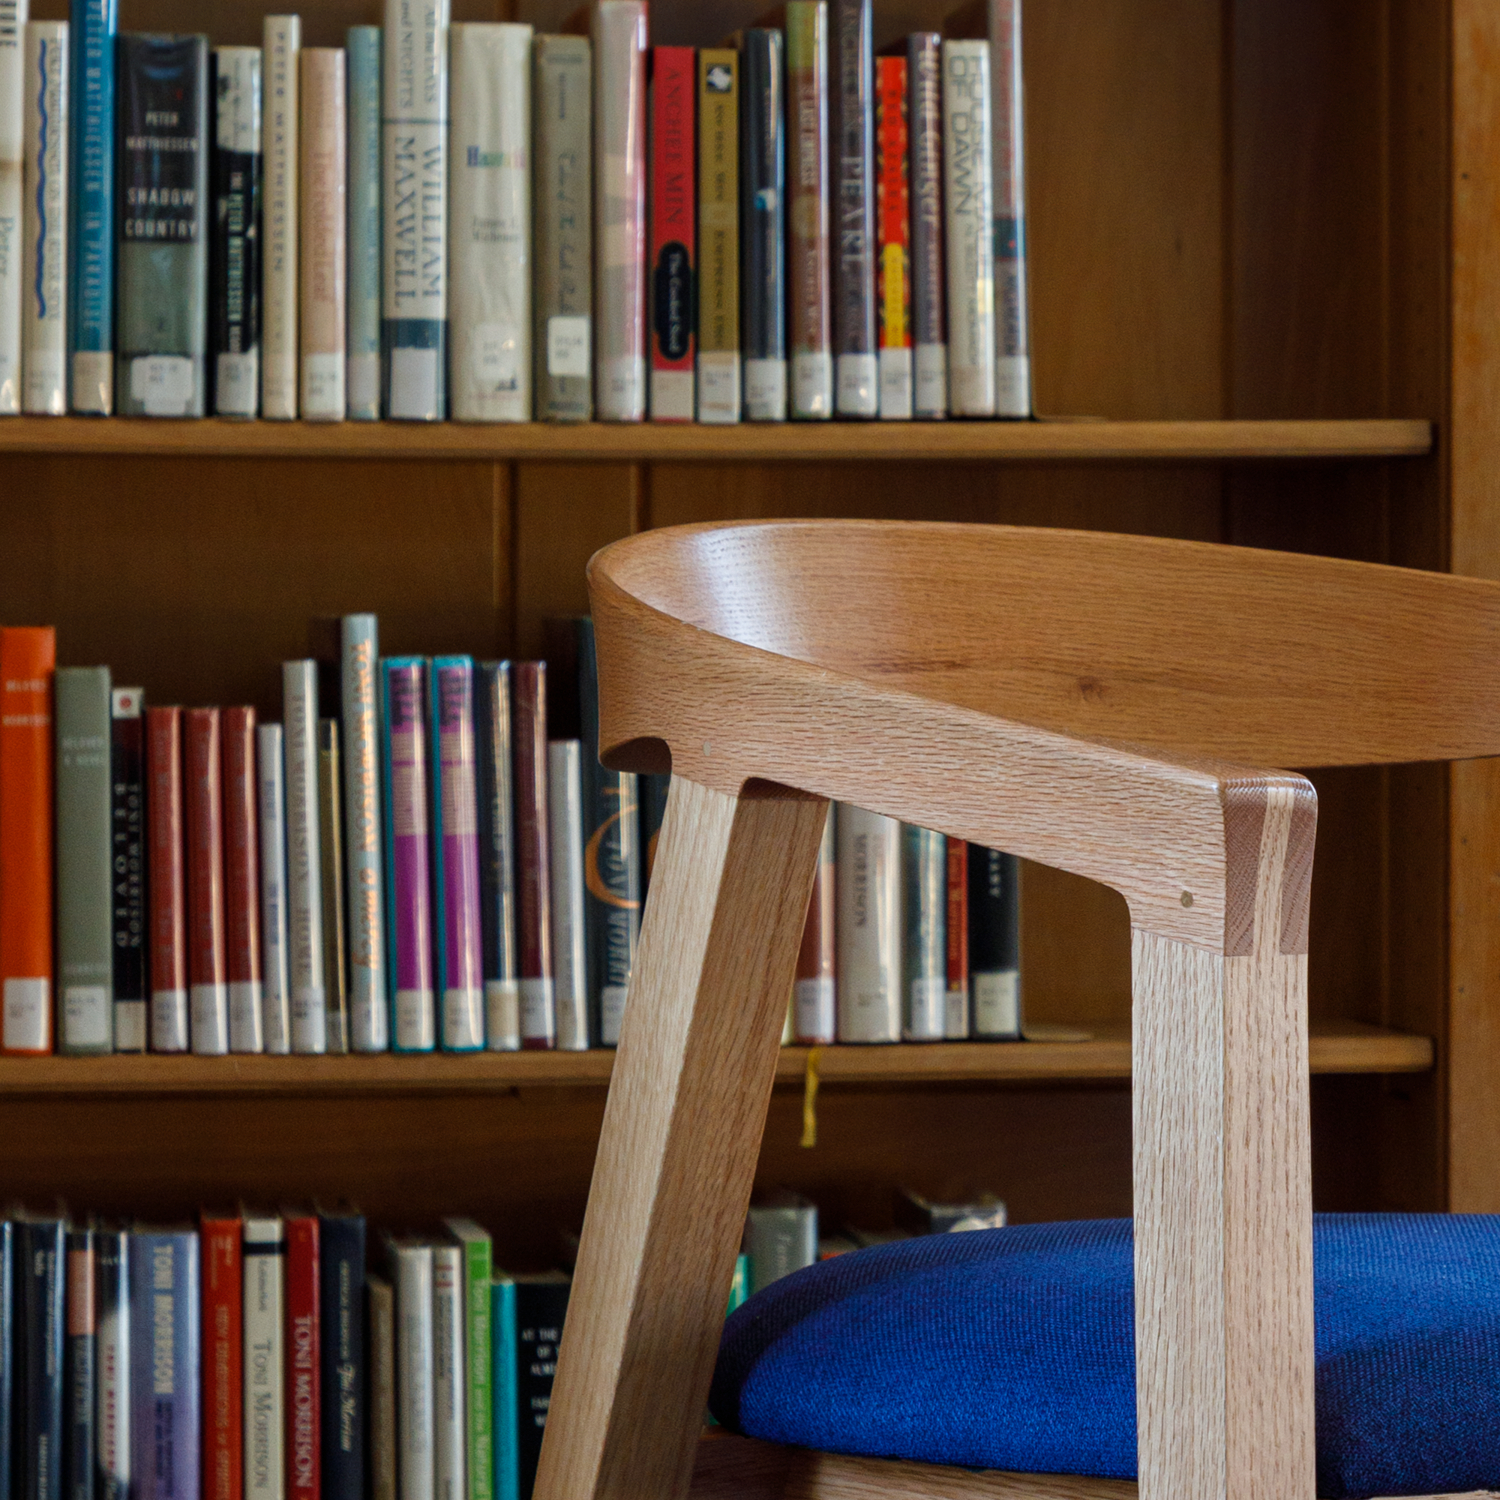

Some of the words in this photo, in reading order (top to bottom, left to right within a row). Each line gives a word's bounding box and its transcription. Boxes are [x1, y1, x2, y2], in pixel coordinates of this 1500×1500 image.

[84, 0, 102, 59] PETER
[274, 31, 287, 99] PETER
[950, 55, 972, 98] OF
[84, 67, 102, 193] MATTHIESSEN
[665, 66, 682, 163] ANCHEE
[127, 187, 195, 207] SHADOW
[273, 112, 287, 272] MATTHIESSEN
[665, 171, 686, 225] MIN
[916, 123, 941, 230] Ginger
[951, 111, 973, 216] DAWN
[126, 219, 198, 238] COUNTRY
[393, 135, 416, 309] MAXWELL
[421, 145, 443, 296] WILLIAM
[841, 156, 865, 273] PEARL
[84, 240, 101, 329] PARADISE
[348, 640, 374, 704] TONI
[294, 908, 314, 976] HOME
[153, 1244, 174, 1289] TONI
[474, 1278, 490, 1310] Toni
[153, 1295, 174, 1394] MORRISON
[294, 1314, 312, 1367] TONI
[473, 1314, 490, 1385] Morrison
[293, 1373, 312, 1488] MORRISON
[474, 1434, 490, 1492] Natural
